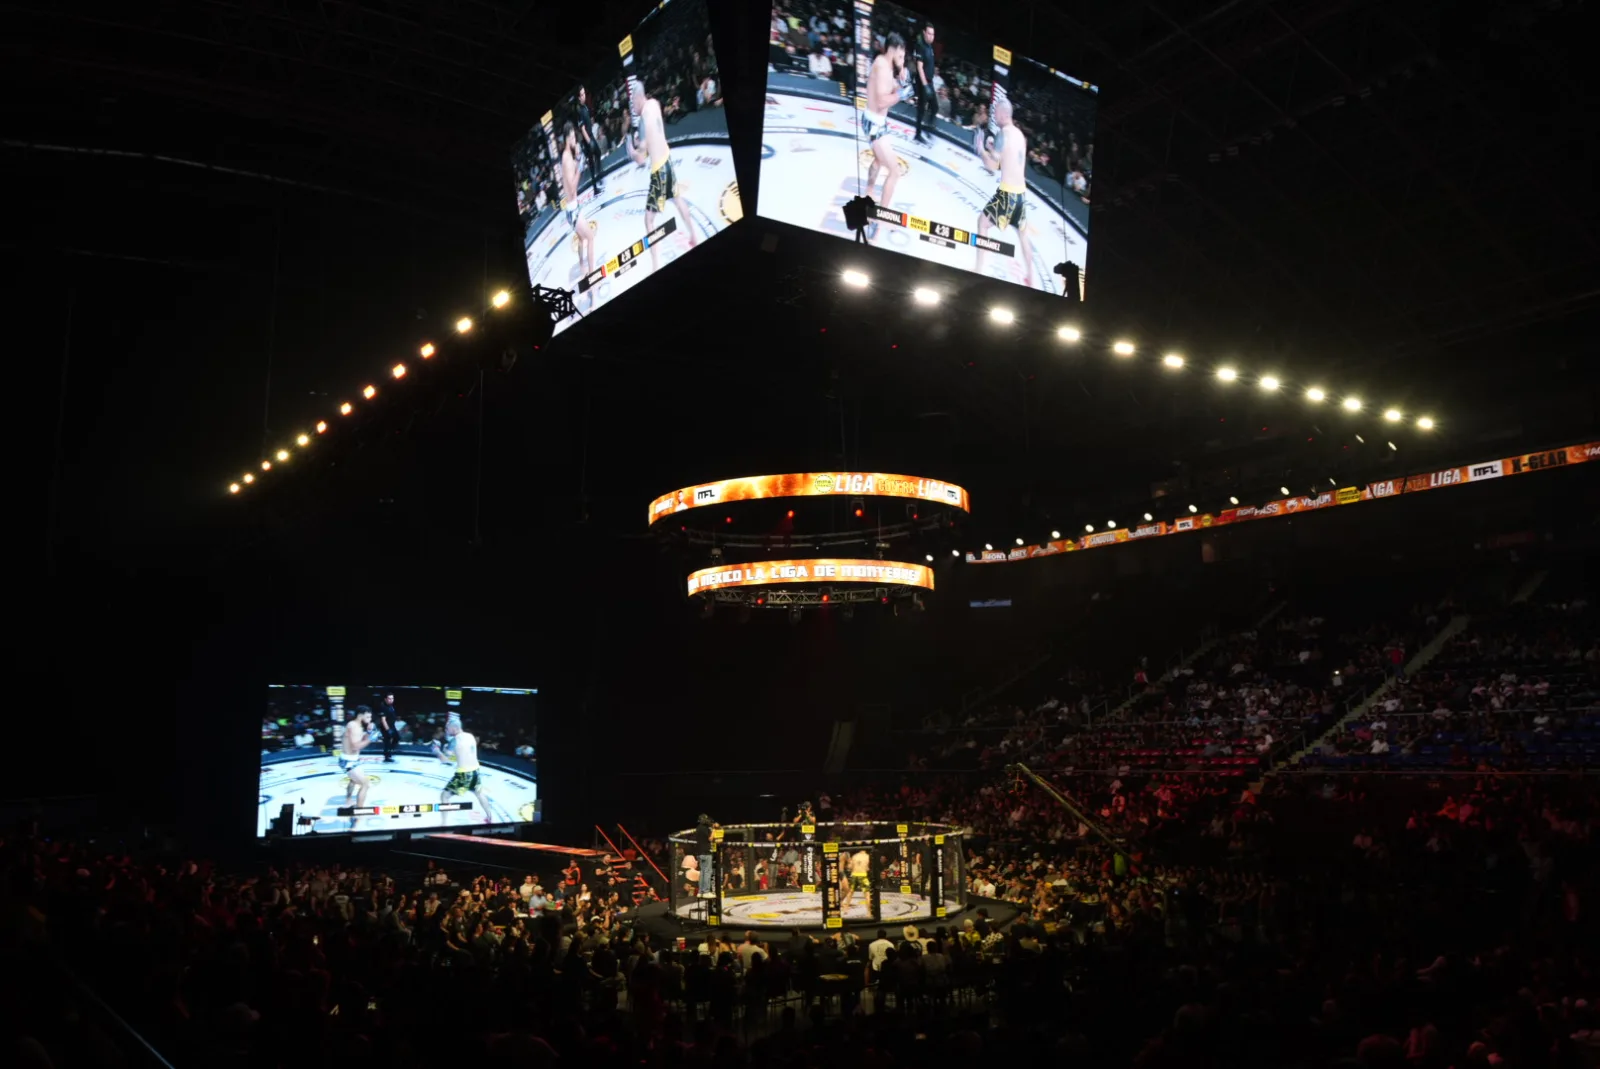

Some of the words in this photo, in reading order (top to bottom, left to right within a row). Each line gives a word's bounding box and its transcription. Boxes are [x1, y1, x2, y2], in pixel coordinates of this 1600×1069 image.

[876, 208, 901, 224] SANDOVAL
[1473, 464, 1498, 477] MFL
[1511, 450, 1568, 473] X-GEAR
[697, 489, 715, 500] MFL
[834, 474, 875, 493] LIGA
[878, 478, 915, 495] CONTRA
[918, 479, 945, 497] LIGA
[1365, 481, 1394, 499] LIGA
[1430, 469, 1461, 487] LIGA
[701, 569, 742, 587] MEXICO
[746, 567, 765, 581] LA
[770, 565, 809, 579] LIGA
[813, 565, 836, 577] DE
